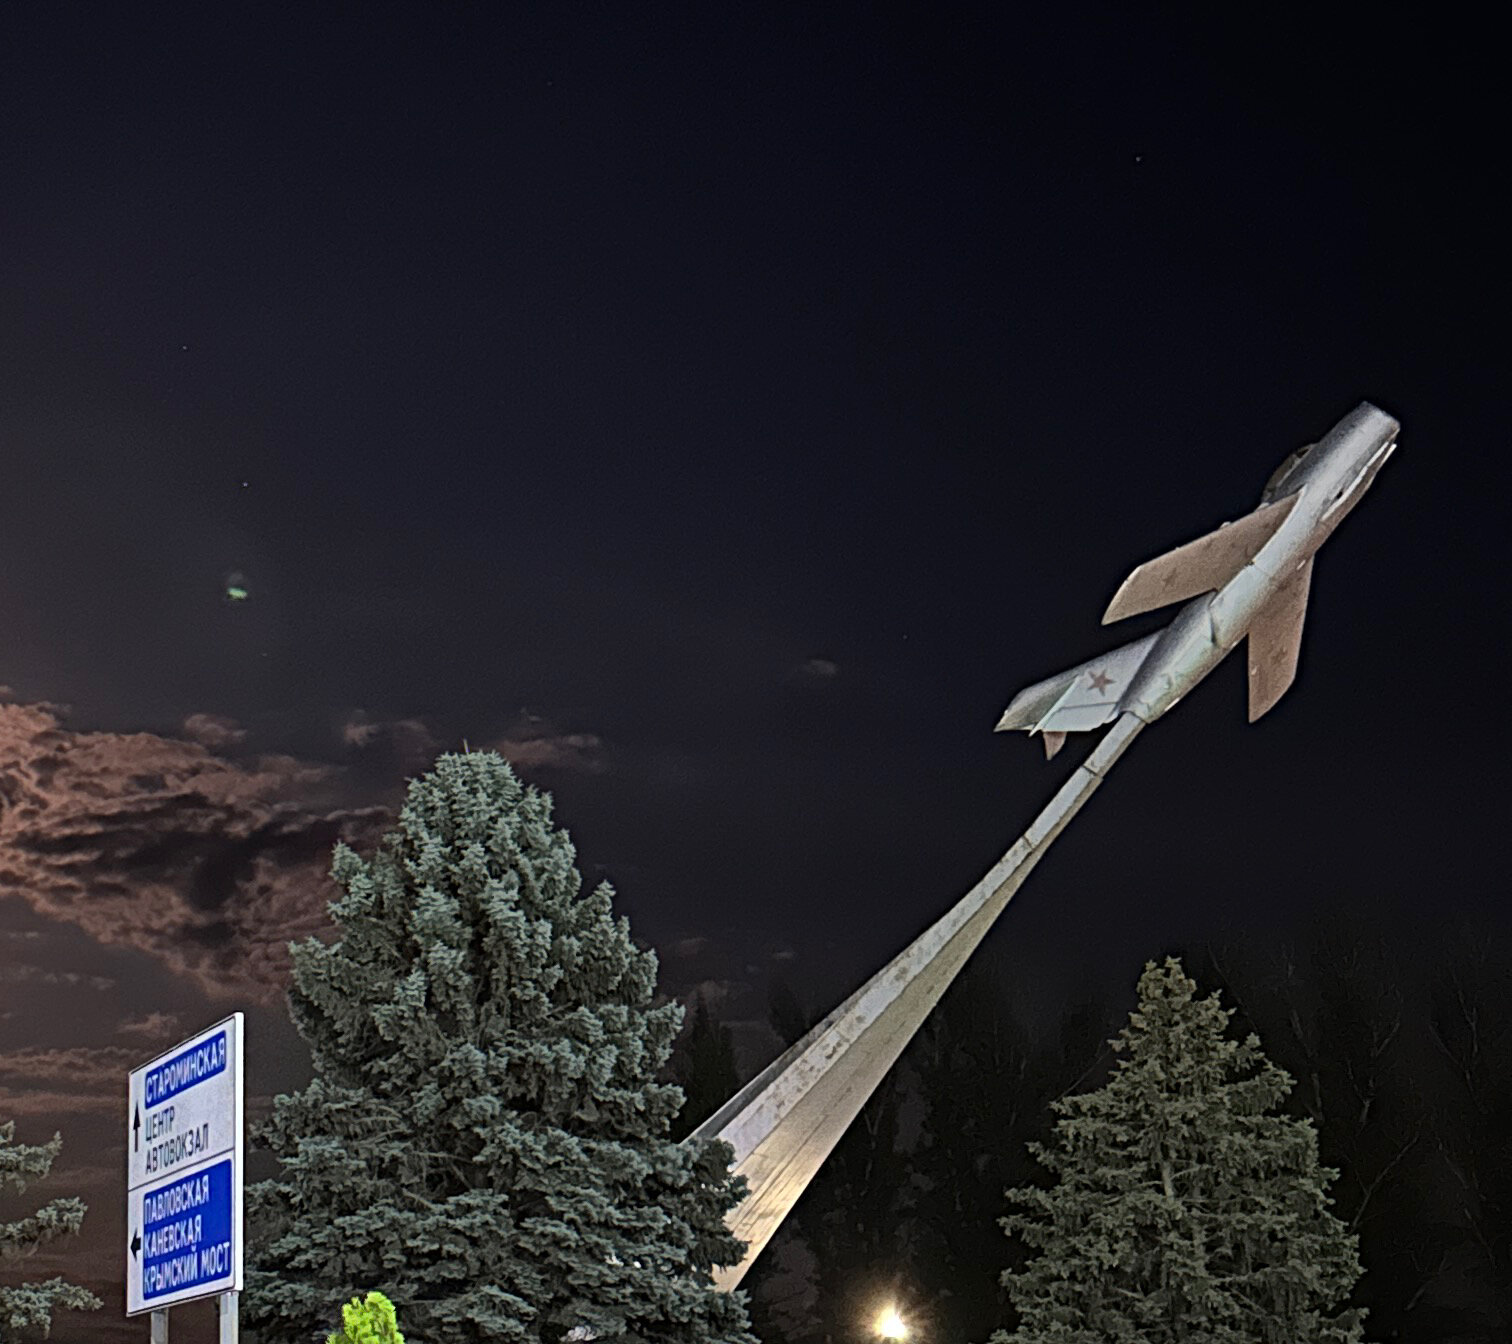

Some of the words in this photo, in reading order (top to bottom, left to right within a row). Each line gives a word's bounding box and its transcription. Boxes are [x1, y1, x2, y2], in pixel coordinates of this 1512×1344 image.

[146, 1037, 225, 1103] СТАРОМИНСКАЯ
[145, 1106, 175, 1144] ЦЕНТР
[145, 1123, 209, 1175] АВТОВОКЗАЛ
[145, 1174, 209, 1225] ПАВЛОВСКАЯ
[144, 1214, 202, 1259] КАНЕВСКАЯ
[144, 1244, 198, 1293] КРЫМСКИЙ
[201, 1241, 230, 1278] МОСТ
